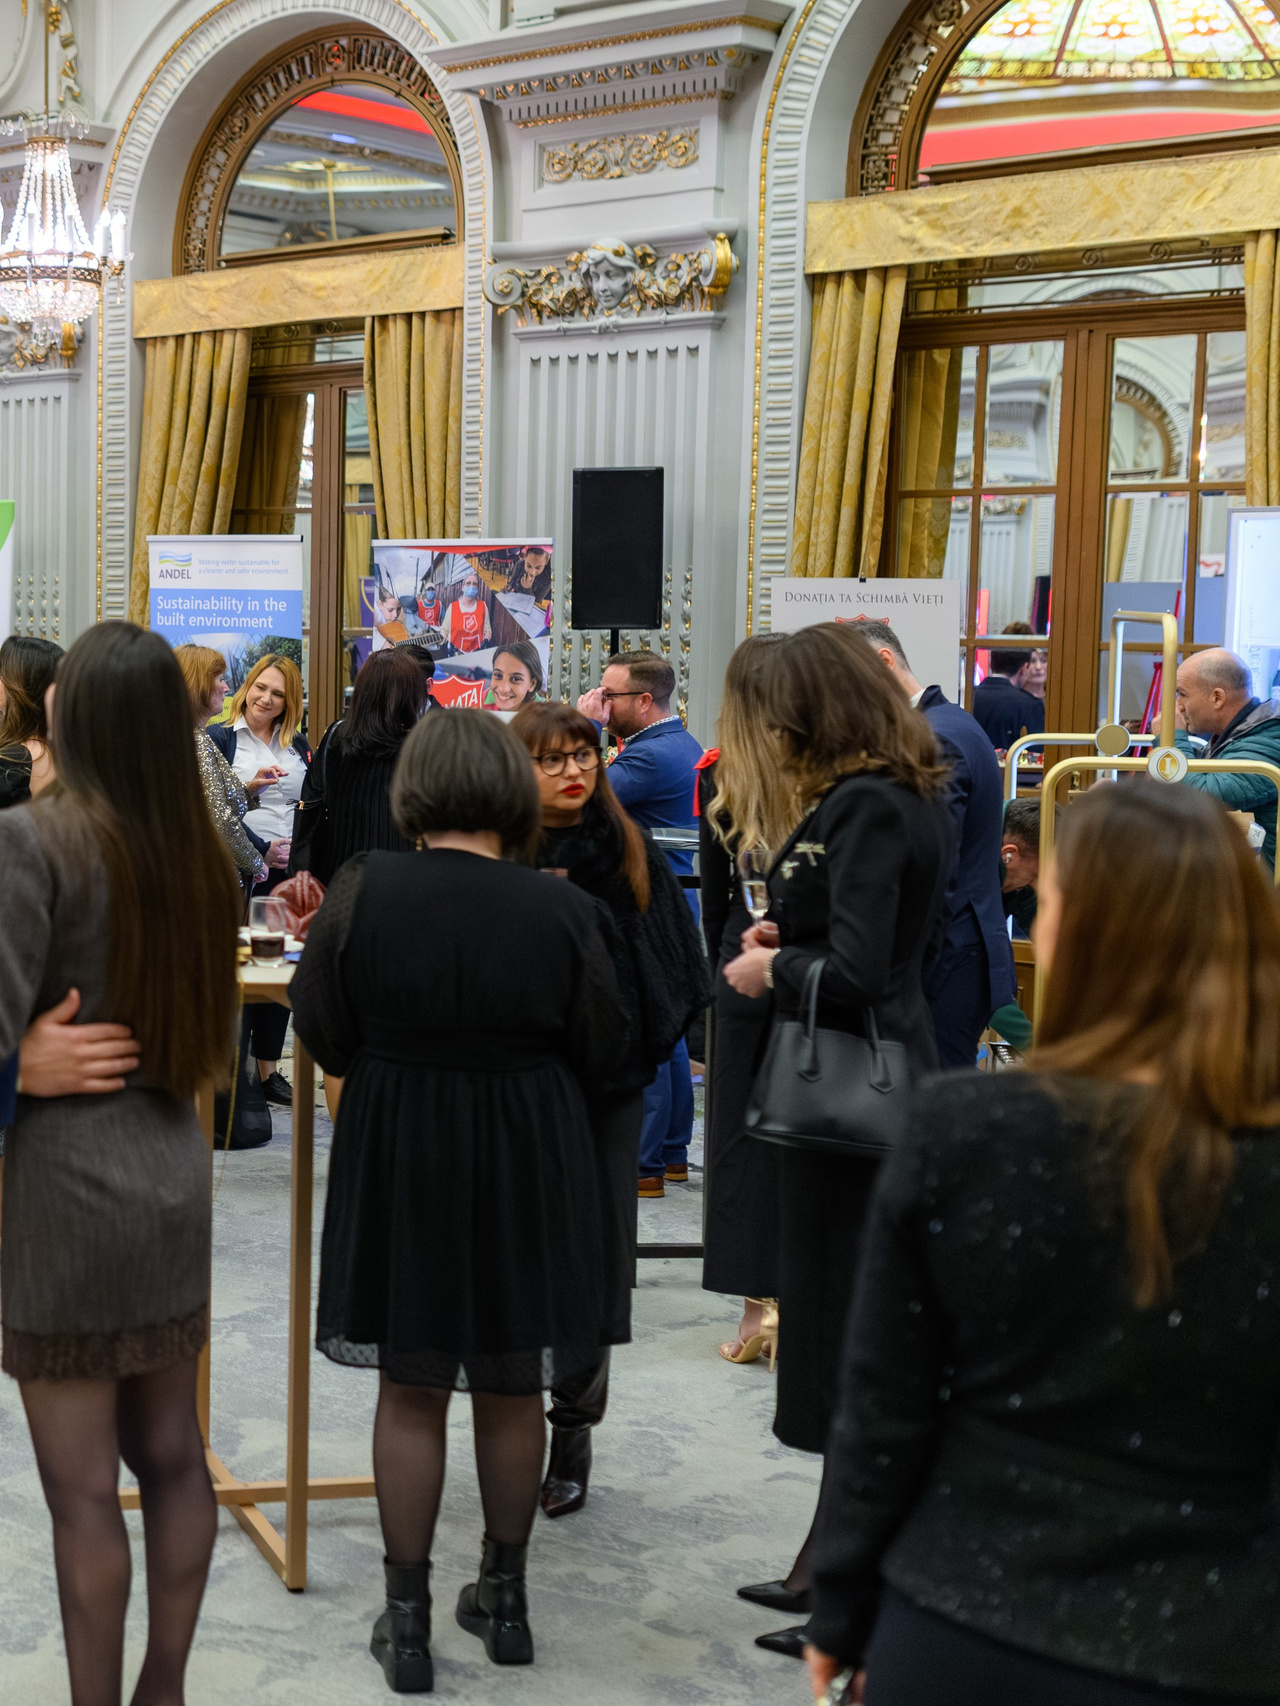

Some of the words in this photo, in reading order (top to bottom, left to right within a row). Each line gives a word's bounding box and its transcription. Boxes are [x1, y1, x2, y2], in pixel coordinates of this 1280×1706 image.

[159, 569, 191, 579] ANDEL
[157, 596, 244, 614] Sustainability
[248, 597, 259, 611] in
[264, 597, 287, 612] the
[157, 612, 185, 626] built
[189, 613, 273, 628] environment
